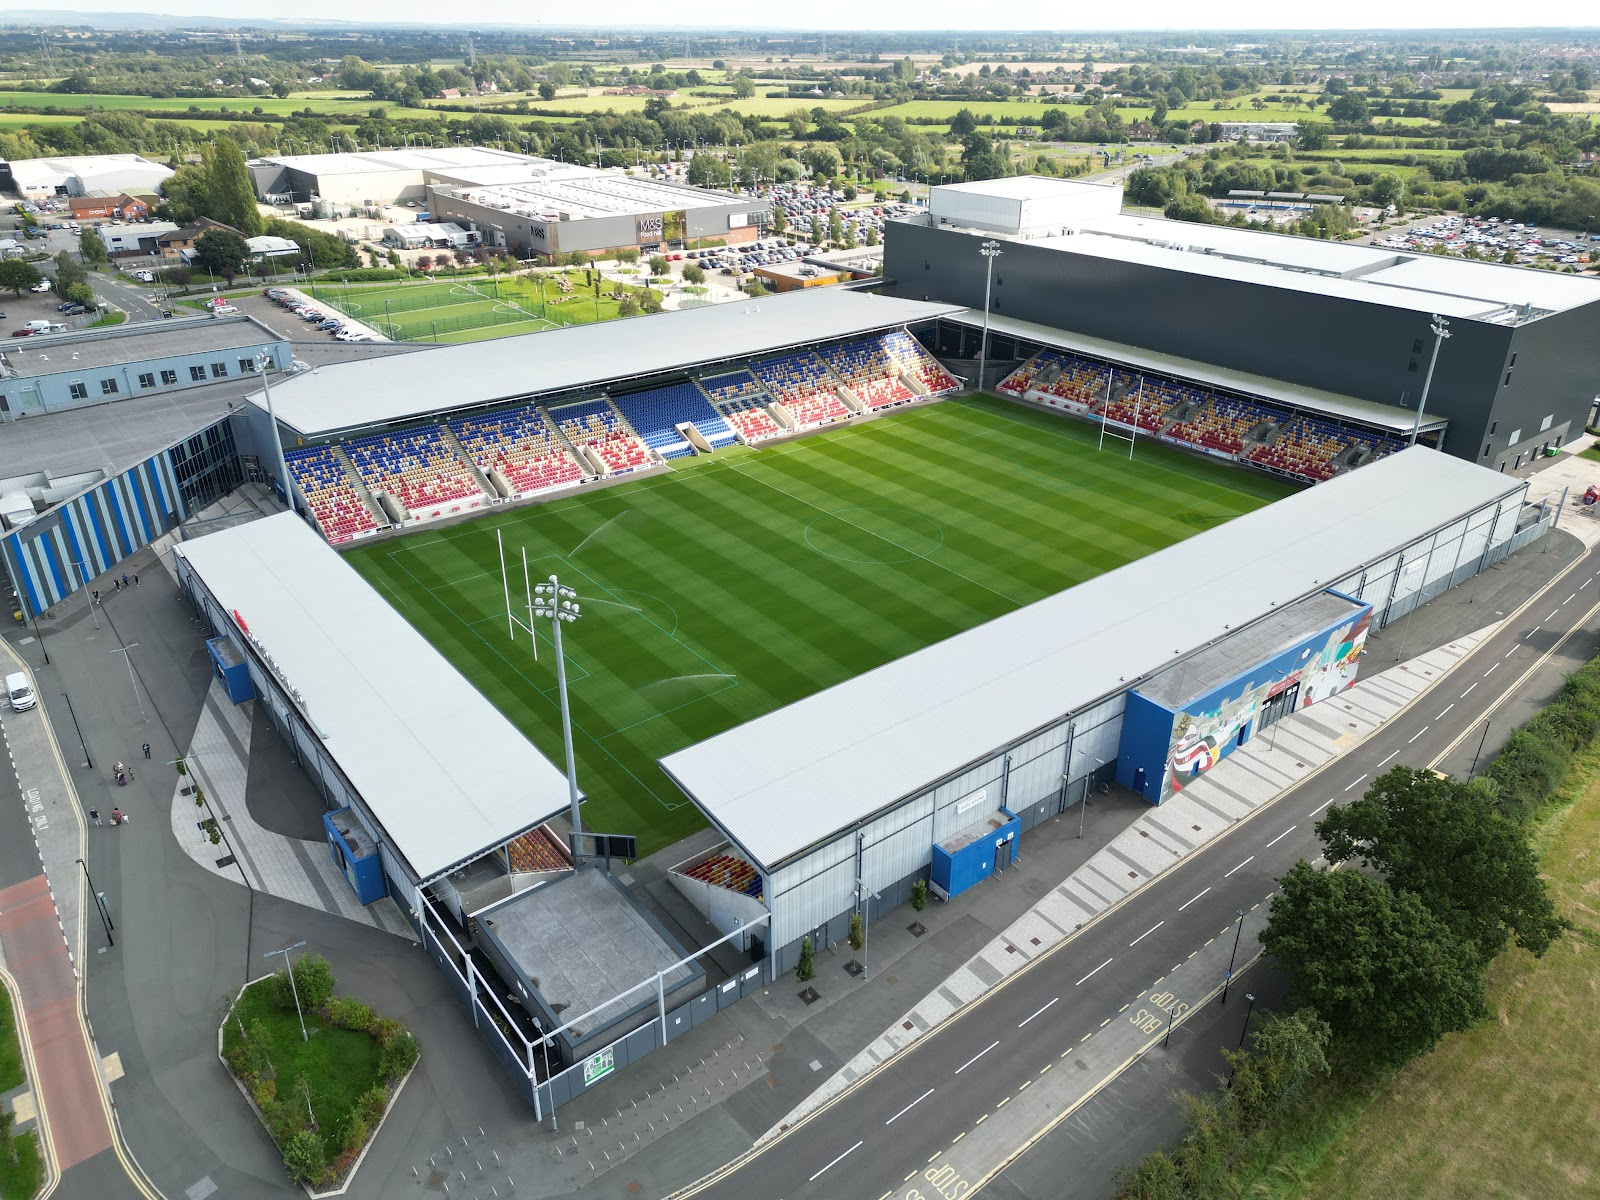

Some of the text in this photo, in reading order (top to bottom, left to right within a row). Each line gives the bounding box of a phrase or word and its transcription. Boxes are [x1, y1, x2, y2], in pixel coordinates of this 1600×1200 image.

[640, 218, 662, 230] M&S
[27, 787, 43, 812] LOADING
[35, 816, 49, 830] ONLY
[1149, 991, 1189, 1018] STOP
[1129, 1008, 1163, 1035] BUS
[924, 1163, 969, 1200] STOP
